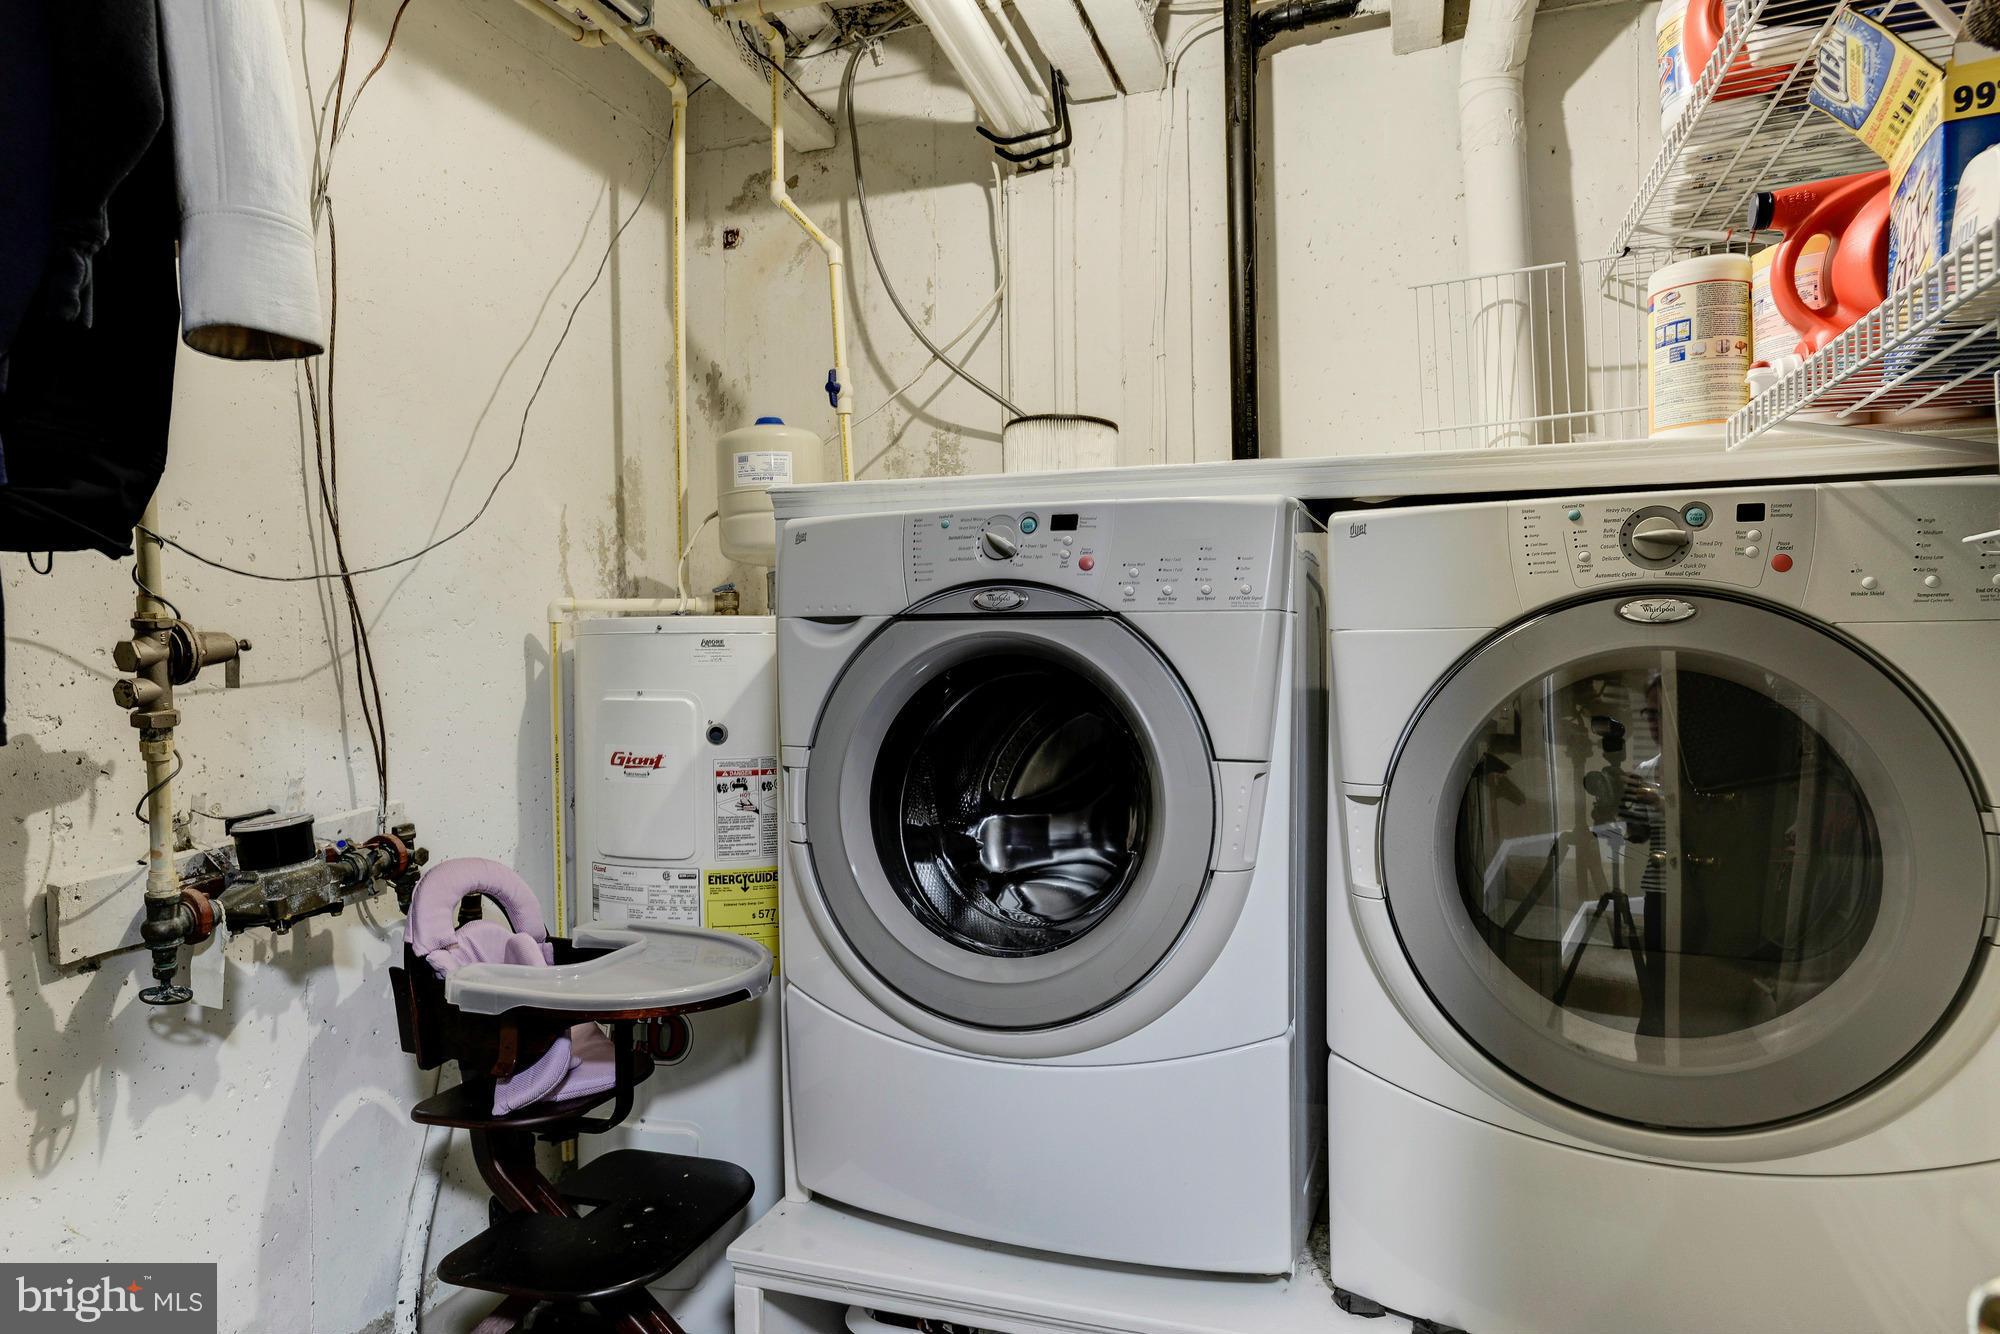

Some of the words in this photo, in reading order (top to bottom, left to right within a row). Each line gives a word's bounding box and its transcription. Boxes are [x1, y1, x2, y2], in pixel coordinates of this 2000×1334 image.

[1954, 80, 2000, 112] 99
[1642, 605, 1676, 613] Whirlpool
[610, 752, 665, 770] Giant
[758, 908, 776, 919] 577
